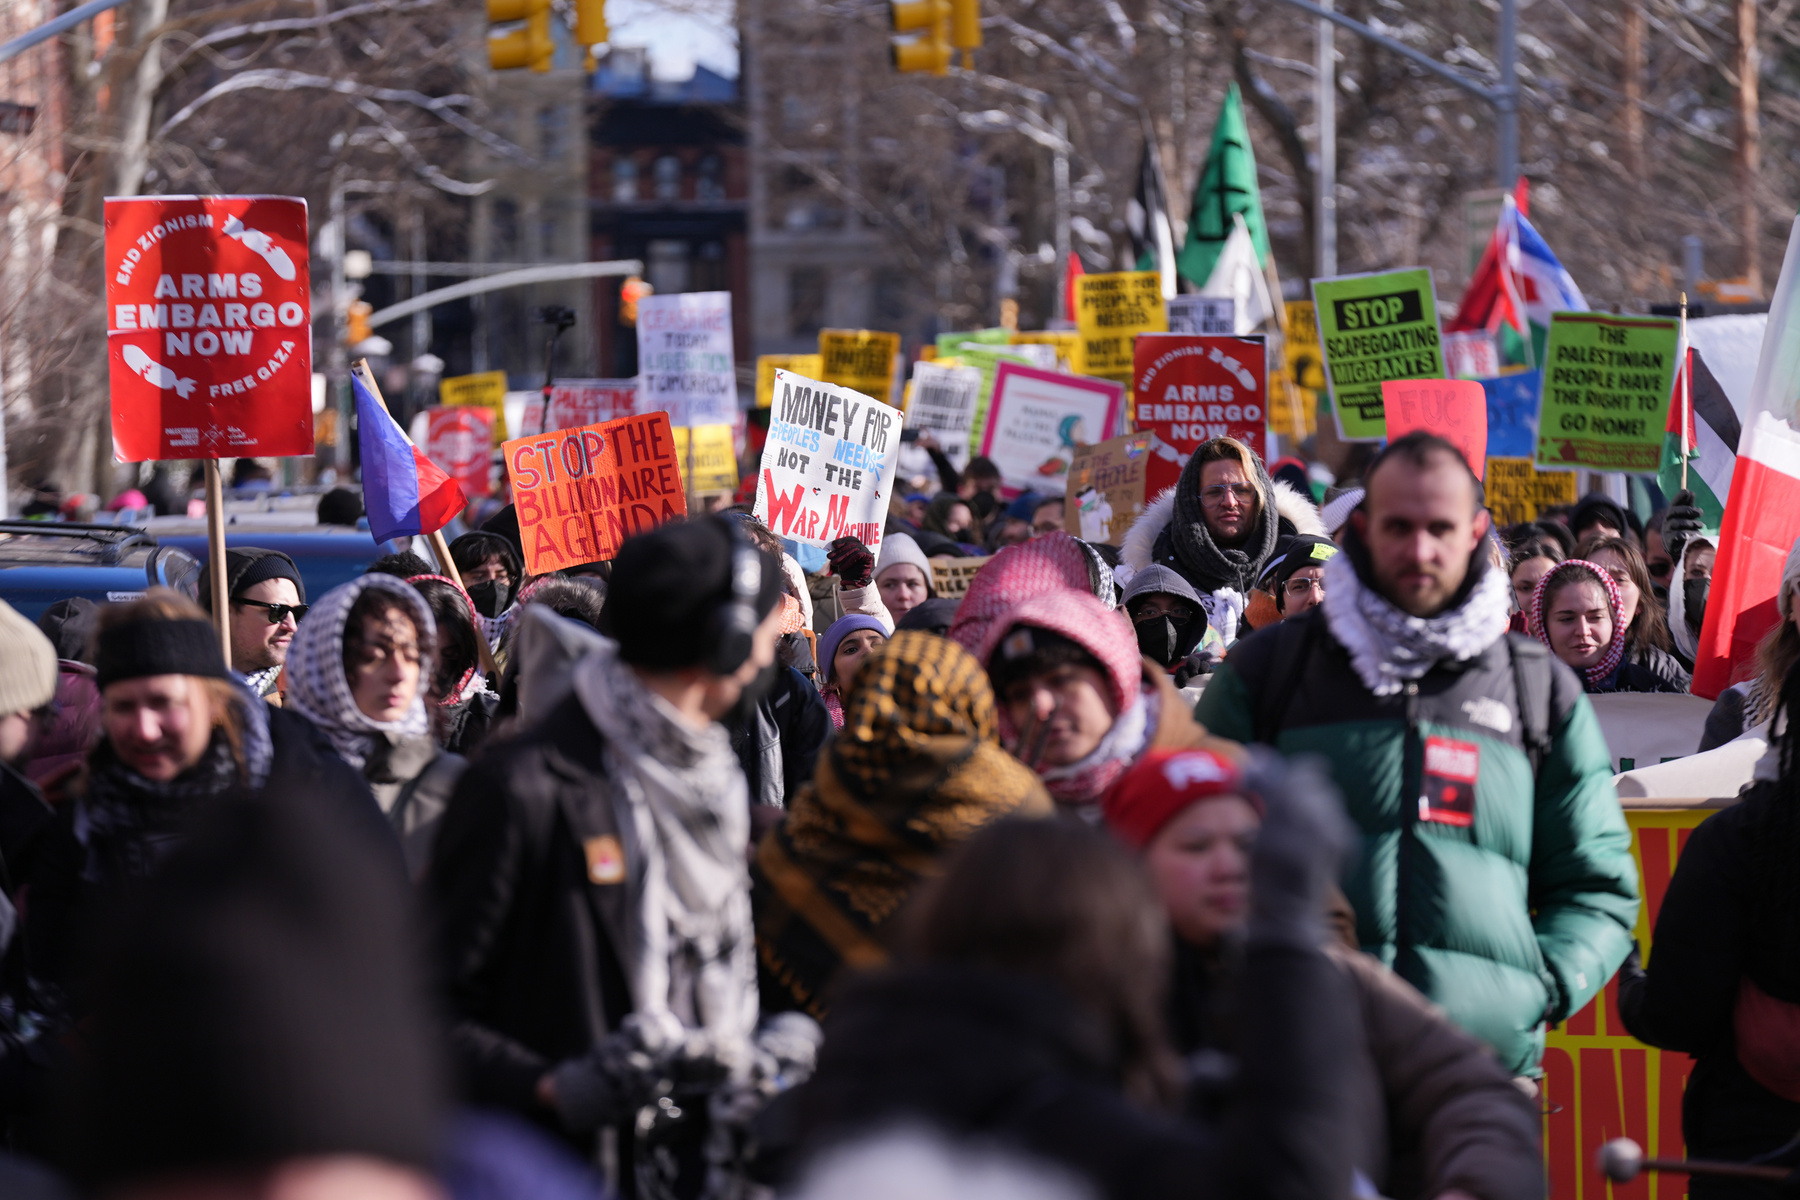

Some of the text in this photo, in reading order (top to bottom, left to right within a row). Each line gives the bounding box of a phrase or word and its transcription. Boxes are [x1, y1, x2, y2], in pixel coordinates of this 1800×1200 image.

[116, 214, 214, 286] END ZIONISM
[154, 273, 263, 299] ARMS
[115, 301, 304, 329] EMBARGO
[1343, 296, 1404, 328] STOP
[165, 330, 254, 356] NOW
[1327, 326, 1439, 359] SCAPEGOATING
[1598, 325, 1628, 345] THE
[209, 340, 296, 398] FREE GAZA
[1153, 345, 1204, 370] ZIONISM
[1331, 354, 1434, 384] MIGRANTS
[1556, 345, 1663, 371] PALESTINIAN
[1552, 366, 1662, 392] PEOPLE HAVE
[1164, 384, 1235, 402] ARMS
[1552, 388, 1659, 412] THE RIGHT TO
[780, 383, 860, 441] MONEY
[862, 407, 892, 453] FOR
[1137, 403, 1261, 421] EMBARGO
[1560, 413, 1646, 437] GO HOME!
[1171, 423, 1228, 440] NOW
[513, 431, 605, 490] STOP
[604, 418, 669, 467] THE
[777, 424, 876, 473] PEOPLE'S NEEDS
[777, 447, 862, 490] NOT THE
[516, 463, 676, 527] BILLIONAIRE
